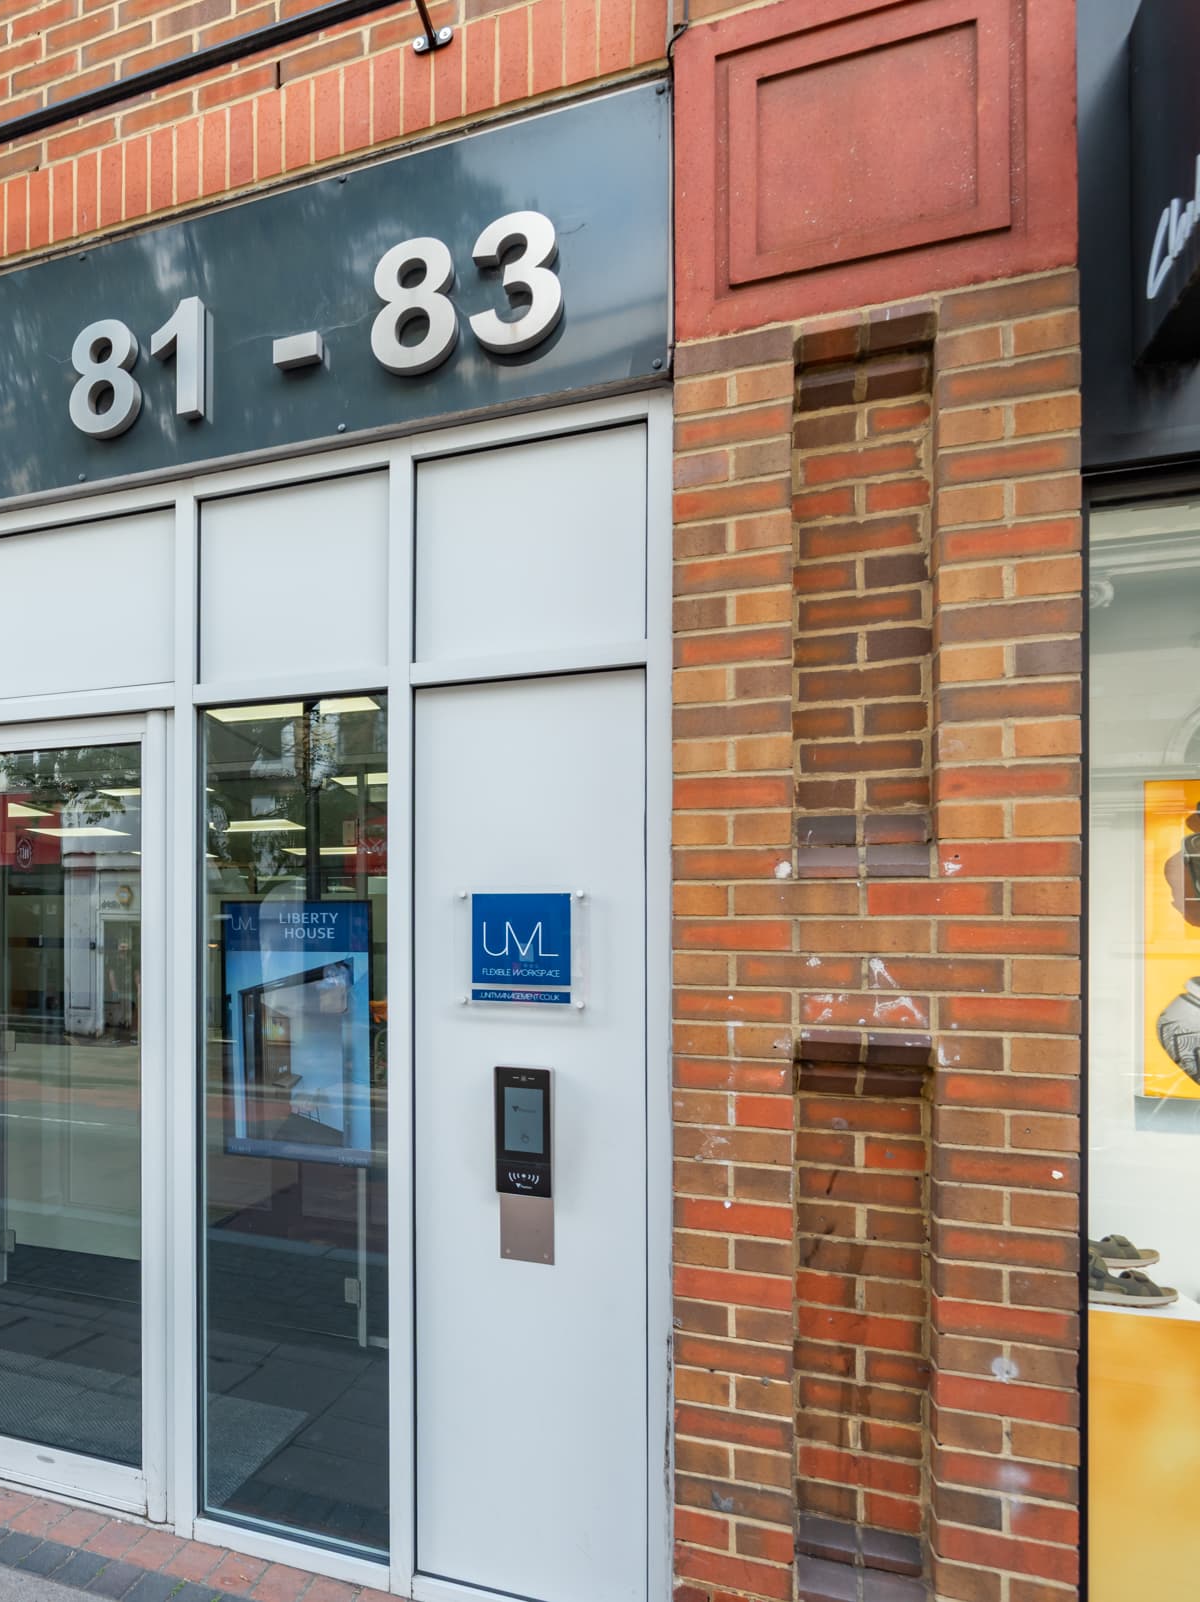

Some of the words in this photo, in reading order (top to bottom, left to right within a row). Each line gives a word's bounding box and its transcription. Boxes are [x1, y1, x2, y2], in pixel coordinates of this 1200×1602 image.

[69, 295, 206, 439] 81
[370, 210, 564, 376] 83
[279, 912, 339, 924] LIBERTY
[284, 927, 336, 939] HOUSE
[483, 921, 560, 956] UML
[482, 967, 511, 977] FLEXIBLE
[512, 968, 561, 978] WORKSPACE
